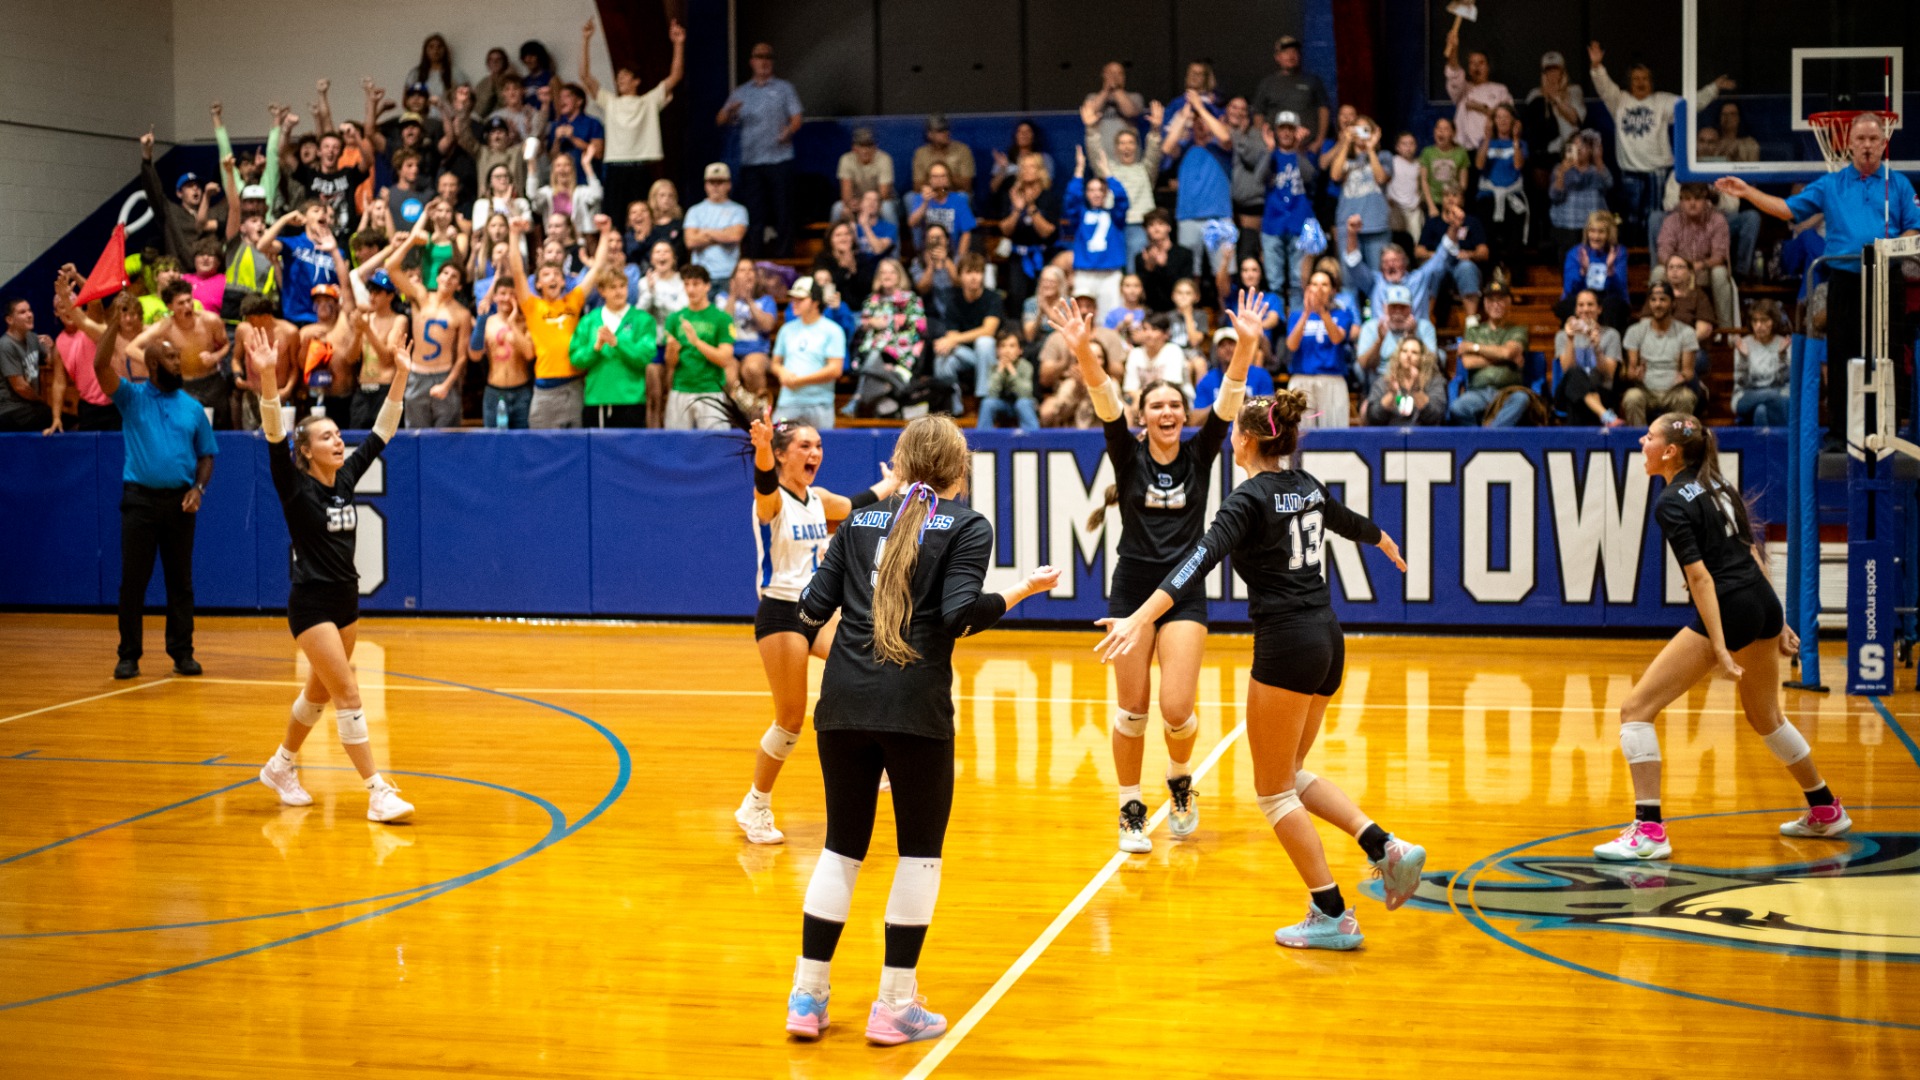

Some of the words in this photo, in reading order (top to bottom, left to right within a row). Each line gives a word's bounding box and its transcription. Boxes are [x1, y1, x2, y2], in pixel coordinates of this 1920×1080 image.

[1084, 211, 1112, 253] 7
[422, 319, 449, 361] S
[852, 511, 892, 529] LADY
[1289, 510, 1324, 570] 13
[1859, 643, 1885, 681] S
